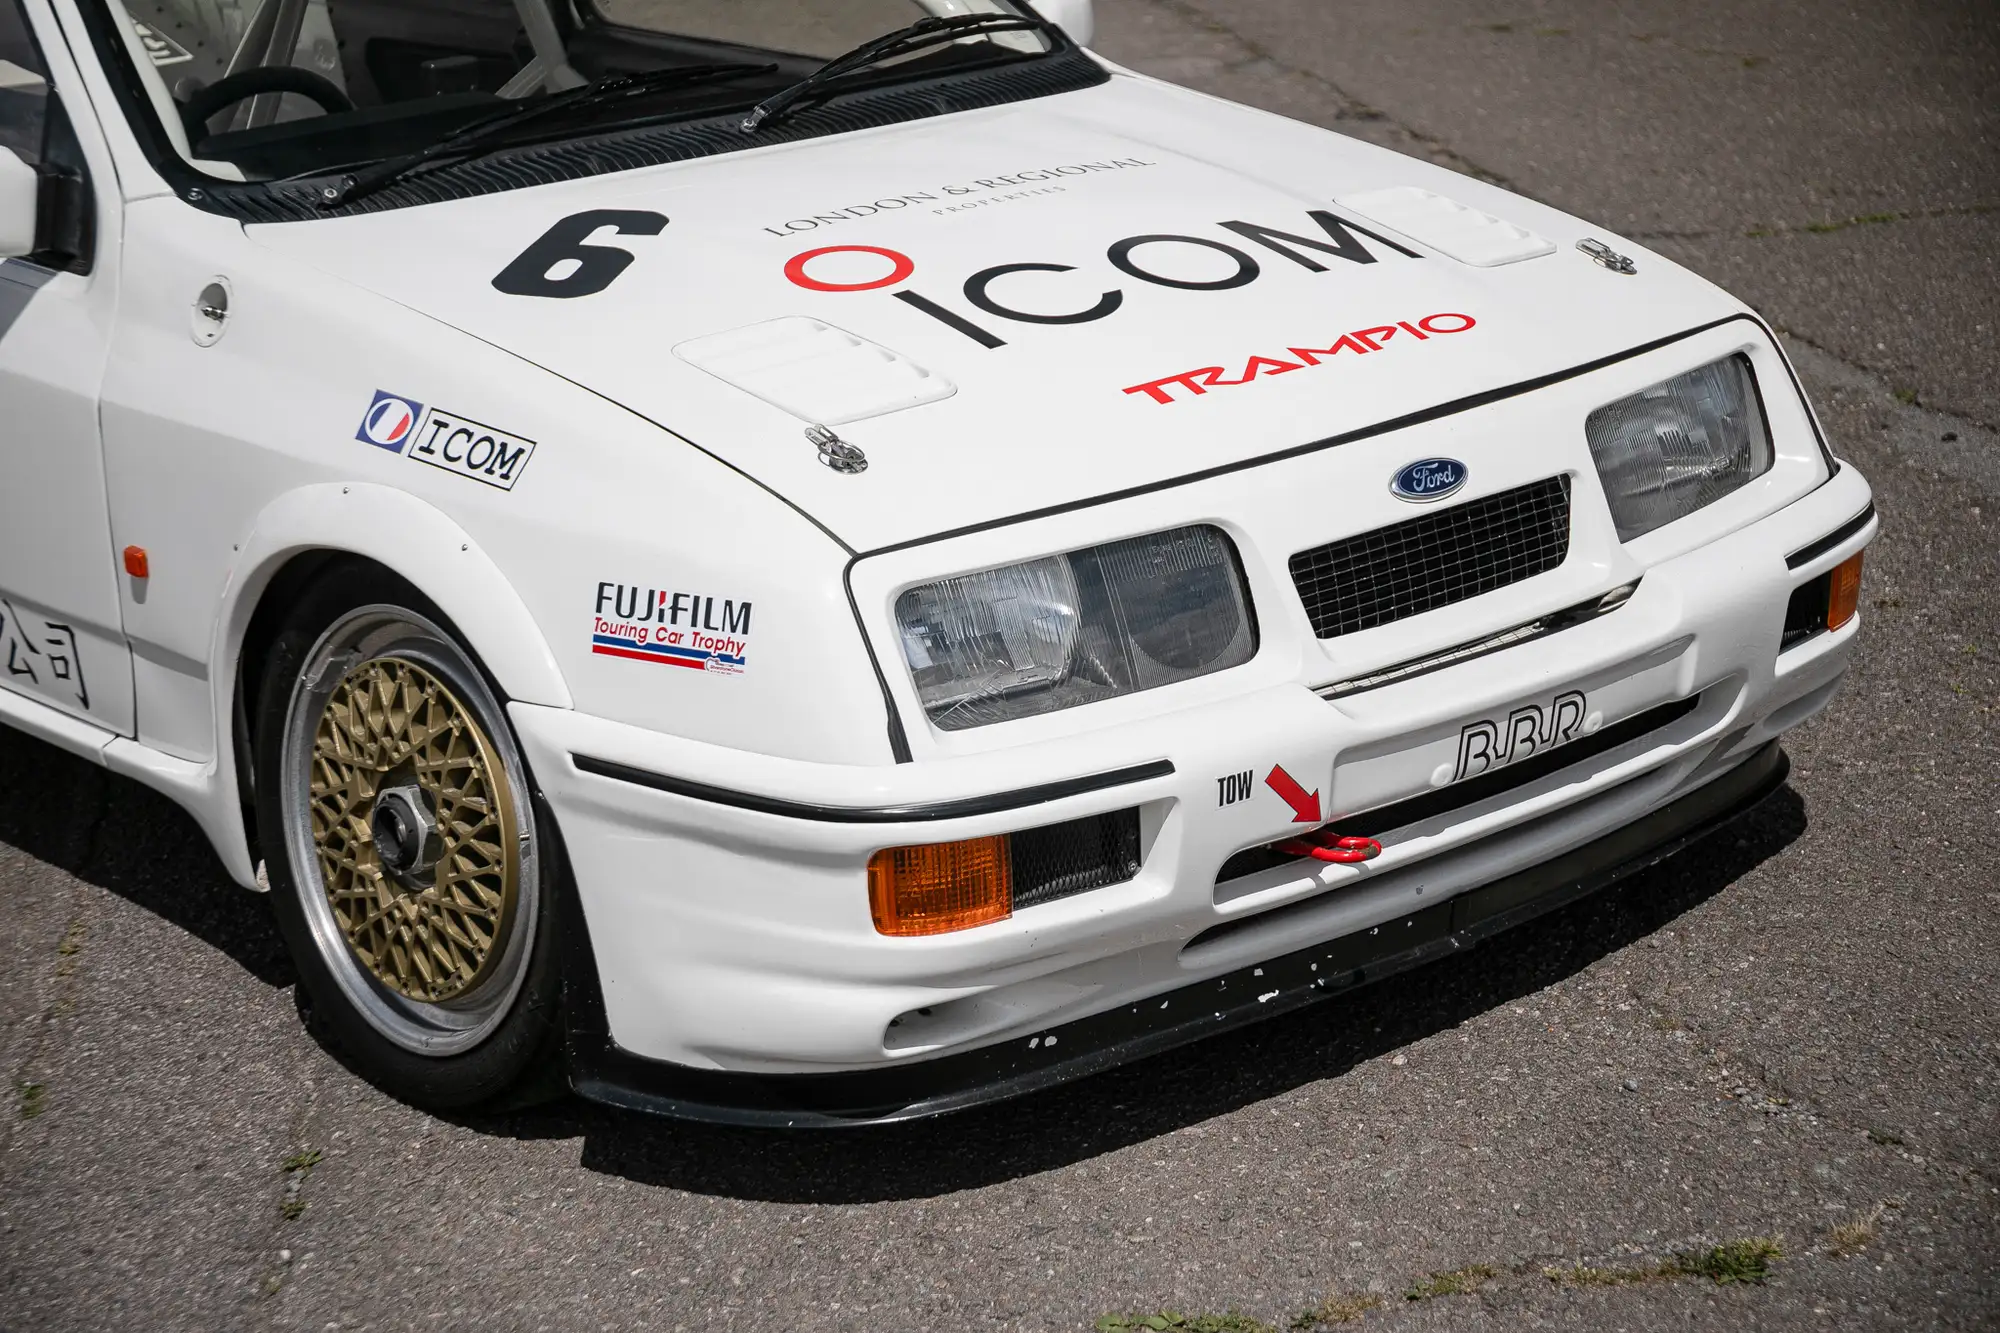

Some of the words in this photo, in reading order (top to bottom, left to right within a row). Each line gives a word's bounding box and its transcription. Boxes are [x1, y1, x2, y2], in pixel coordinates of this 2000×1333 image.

[763, 191, 938, 237] LONDON
[942, 185, 980, 195] &
[974, 157, 1157, 188] REGIONAL
[932, 186, 1066, 215] PROPERTIES
[491, 209, 670, 298] 6
[892, 210, 1424, 350] ICOM
[1122, 313, 1476, 405] TRAMPIO
[418, 419, 526, 481] ICOM
[1412, 462, 1455, 492] Ford
[594, 617, 649, 643] Touring
[655, 627, 684, 644] Car
[692, 631, 746, 657] Trophy
[596, 582, 752, 635] FUJIFILM
[1452, 690, 1586, 783] BBR
[1217, 769, 1253, 807] TOW
